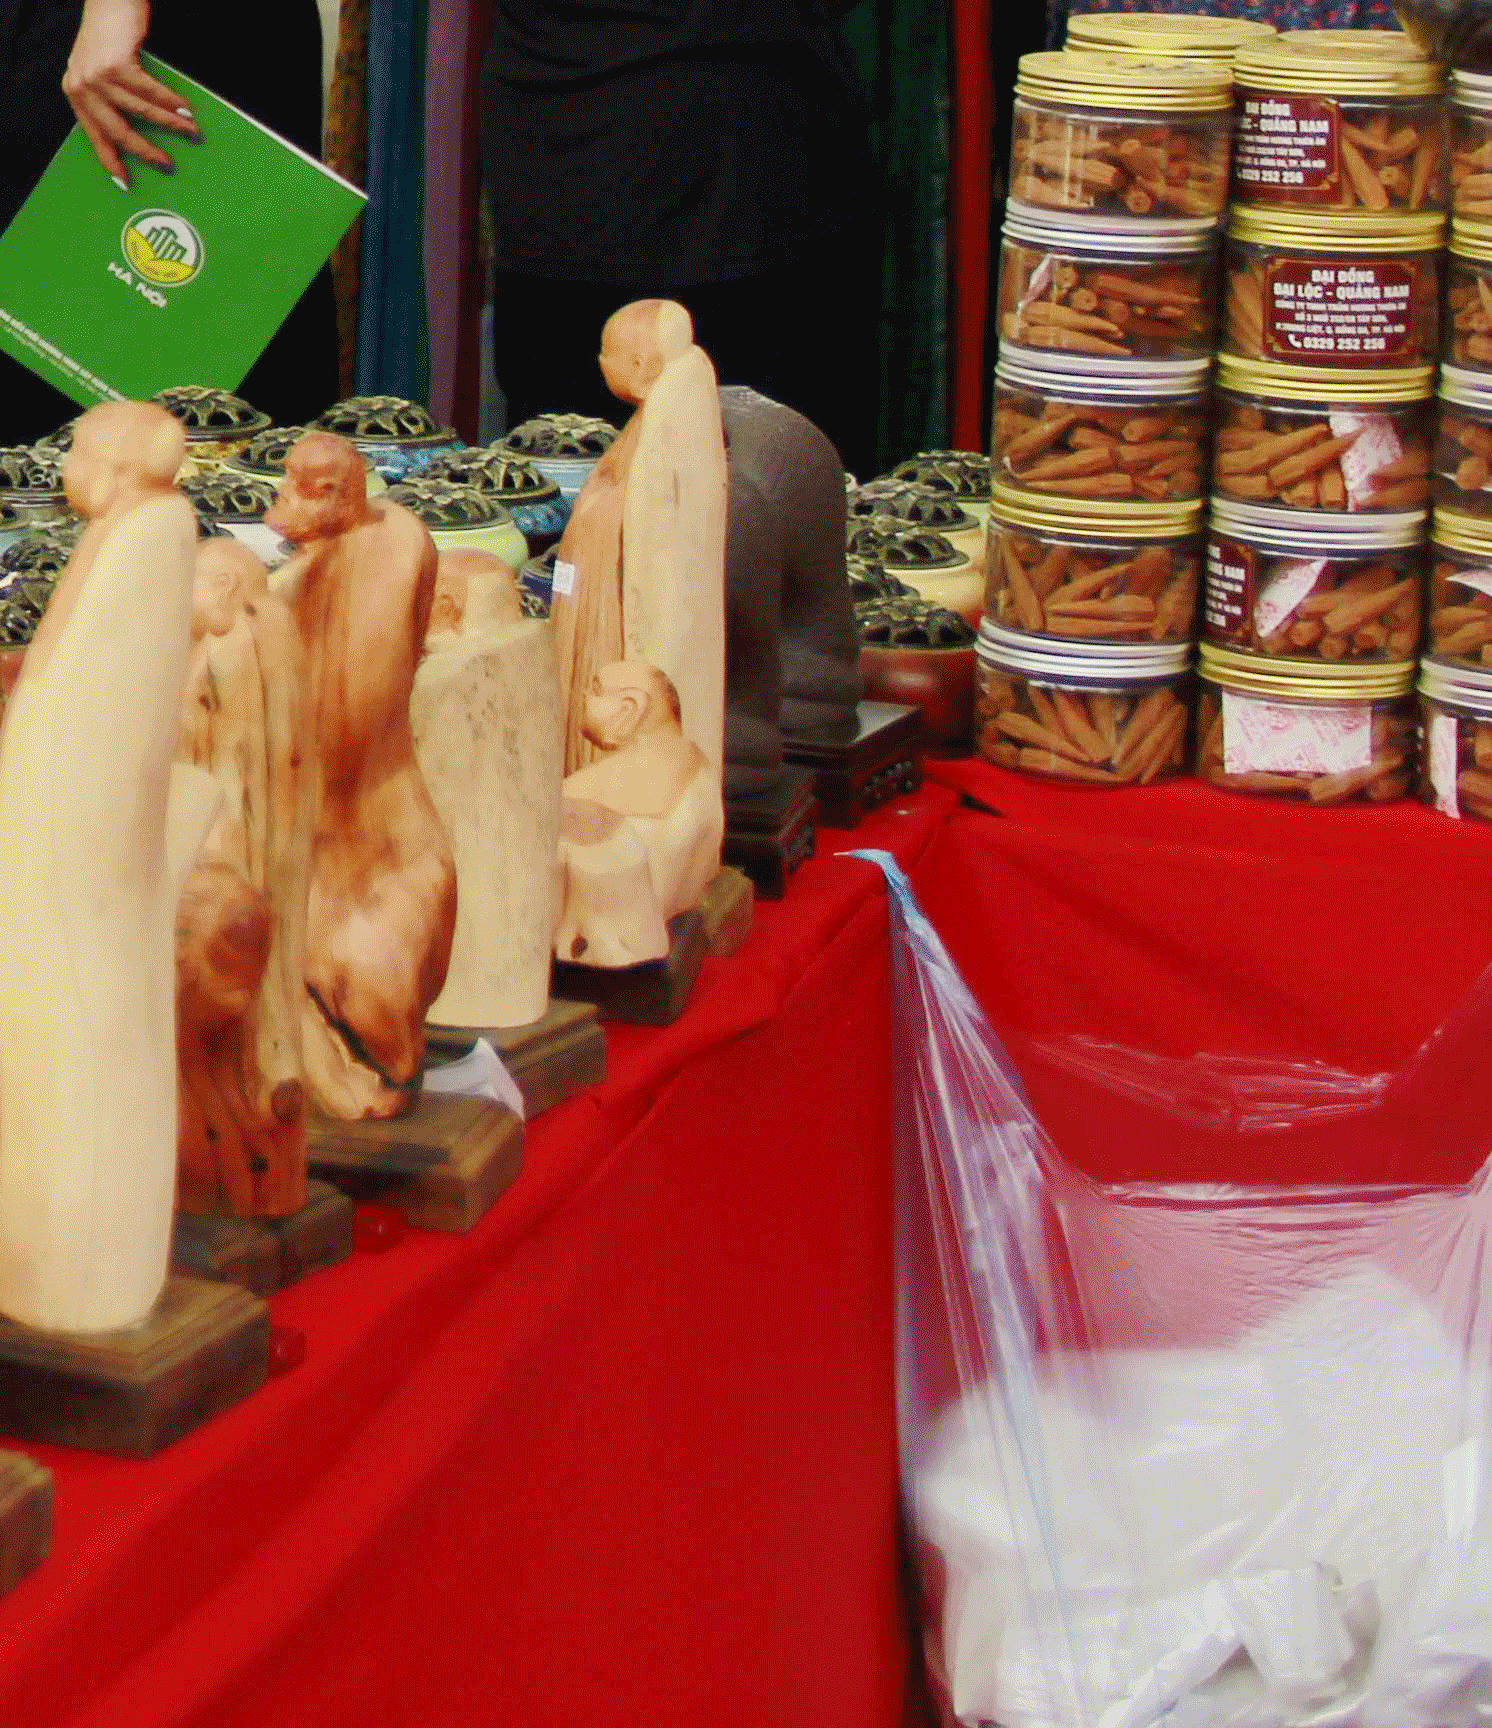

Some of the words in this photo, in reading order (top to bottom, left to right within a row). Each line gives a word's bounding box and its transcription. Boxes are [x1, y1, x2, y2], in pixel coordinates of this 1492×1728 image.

[1299, 120, 1329, 134] NAM
[1297, 282, 1323, 301] LỘC
[1336, 284, 1381, 300] QUẢNG
[1383, 285, 1410, 298] NAM
[1337, 338, 1361, 350] 252
